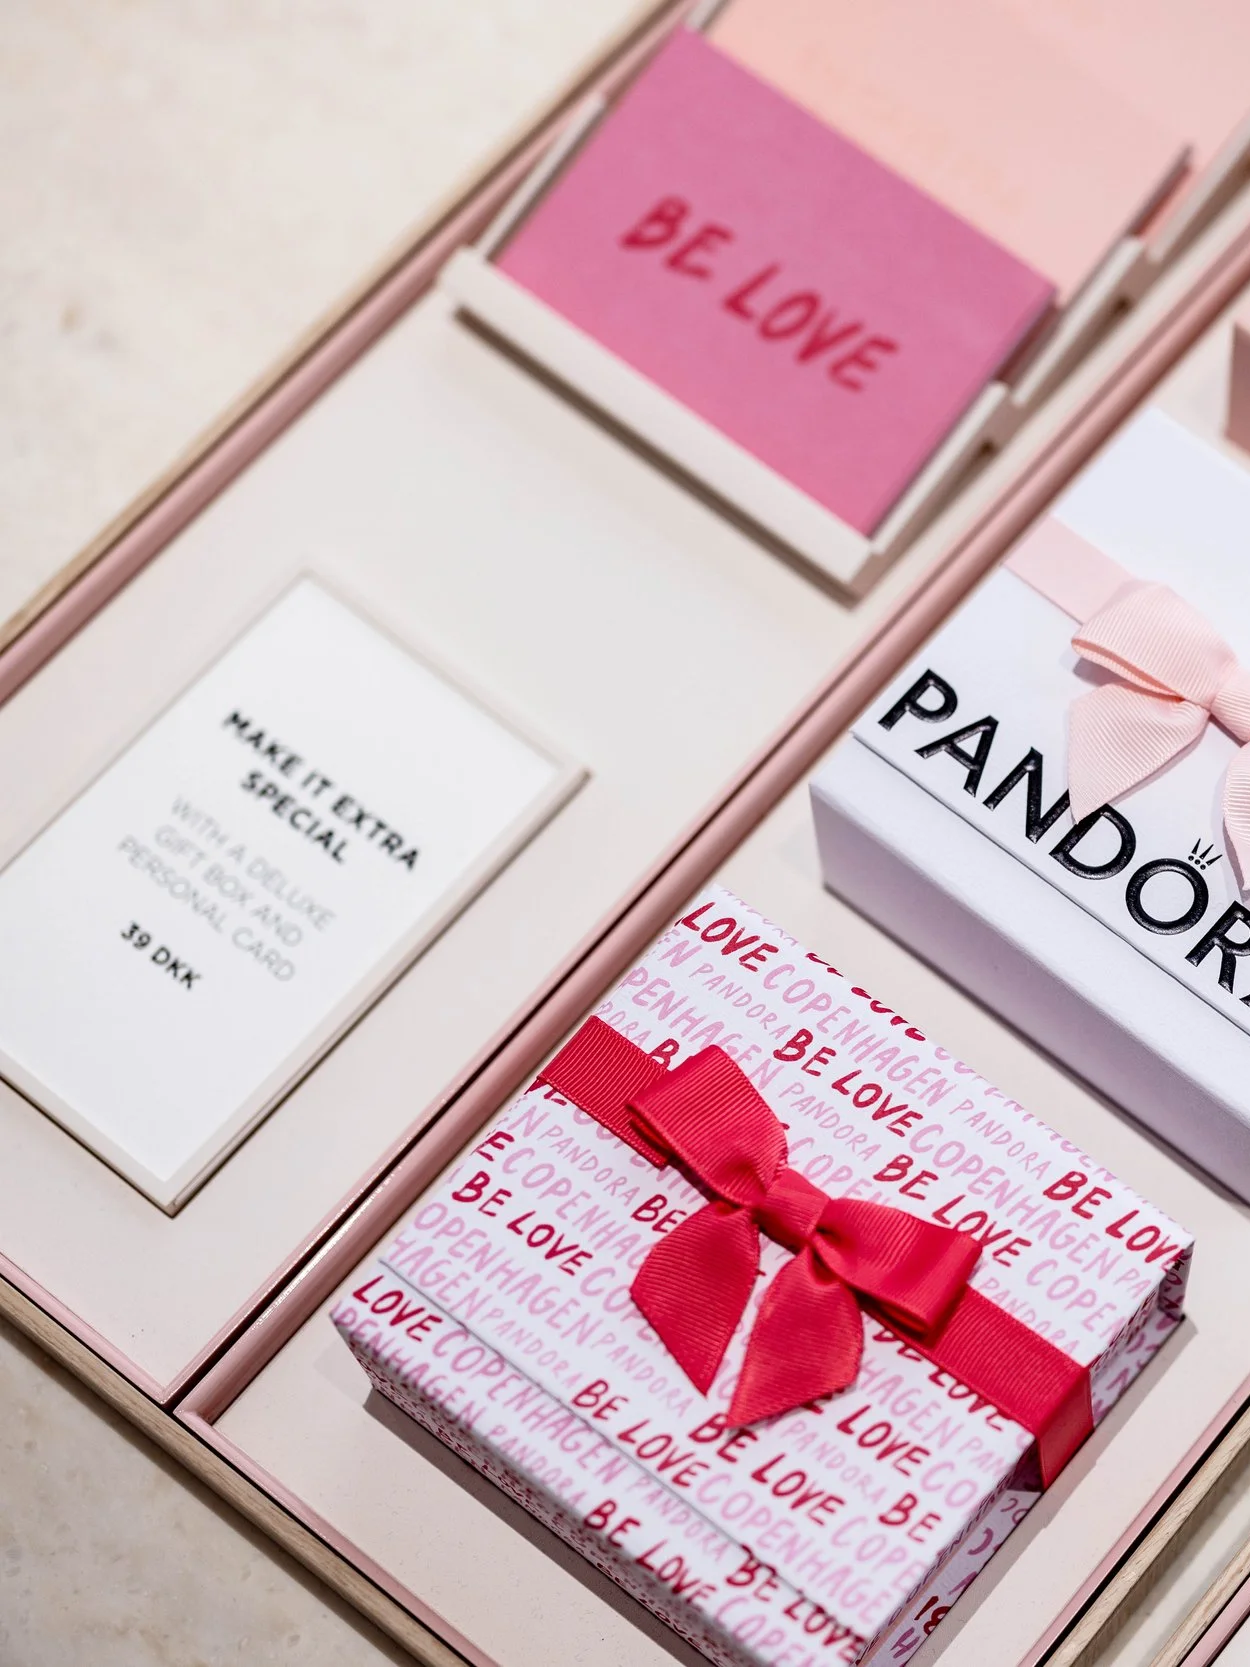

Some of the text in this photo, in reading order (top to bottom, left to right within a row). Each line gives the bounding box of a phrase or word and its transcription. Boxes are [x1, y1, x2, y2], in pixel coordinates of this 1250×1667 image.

[619, 196, 900, 394] BE LOVE
[171, 797, 338, 931] WITH A DELUXE
[222, 709, 421, 872] MAKE IT EXTRA
[240, 769, 349, 865] SPECIAL
[117, 834, 296, 982] PERSONAL CARD
[121, 920, 202, 990] 39 DKK
[154, 824, 304, 948] GIFT BOX AND
[649, 1038, 680, 1072] B
[680, 902, 778, 971] LOVE
[762, 963, 955, 1106] COPENHAGEN
[949, 1098, 1050, 1179] PANDORA
[1042, 1170, 1112, 1219] BE
[693, 962, 790, 1039] PANDORA
[772, 1028, 836, 1076] BE
[831, 1069, 923, 1136] LOVE
[908, 1123, 1121, 1279] COPENHAGEN
[544, 1124, 641, 1207] PANDORA
[631, 1194, 687, 1233] BE
[778, 1081, 880, 1160] PANDORA
[872, 1153, 938, 1200] BE
[931, 1194, 1033, 1268] LOVE
[451, 1170, 512, 1216] BE
[506, 1210, 592, 1276] LOVE
[779, 1413, 885, 1502] PANDORA
[877, 1491, 942, 1543] BE
[484, 1307, 584, 1389] PANDORA
[570, 1377, 626, 1420] BE
[616, 1419, 708, 1488] LOVE
[597, 1333, 695, 1416] PANDORA
[688, 1413, 758, 1463] BE
[750, 1452, 844, 1525] LOVE
[352, 1275, 442, 1341] LOVE
[431, 1320, 628, 1484] COPENHAGEN
[633, 1473, 731, 1560] PANDORA
[726, 1547, 778, 1602] BE
[783, 1591, 866, 1664] LOVE
[835, 1404, 930, 1475] LOVE
[583, 1499, 641, 1549] BE
[636, 1538, 716, 1603] LOVE
